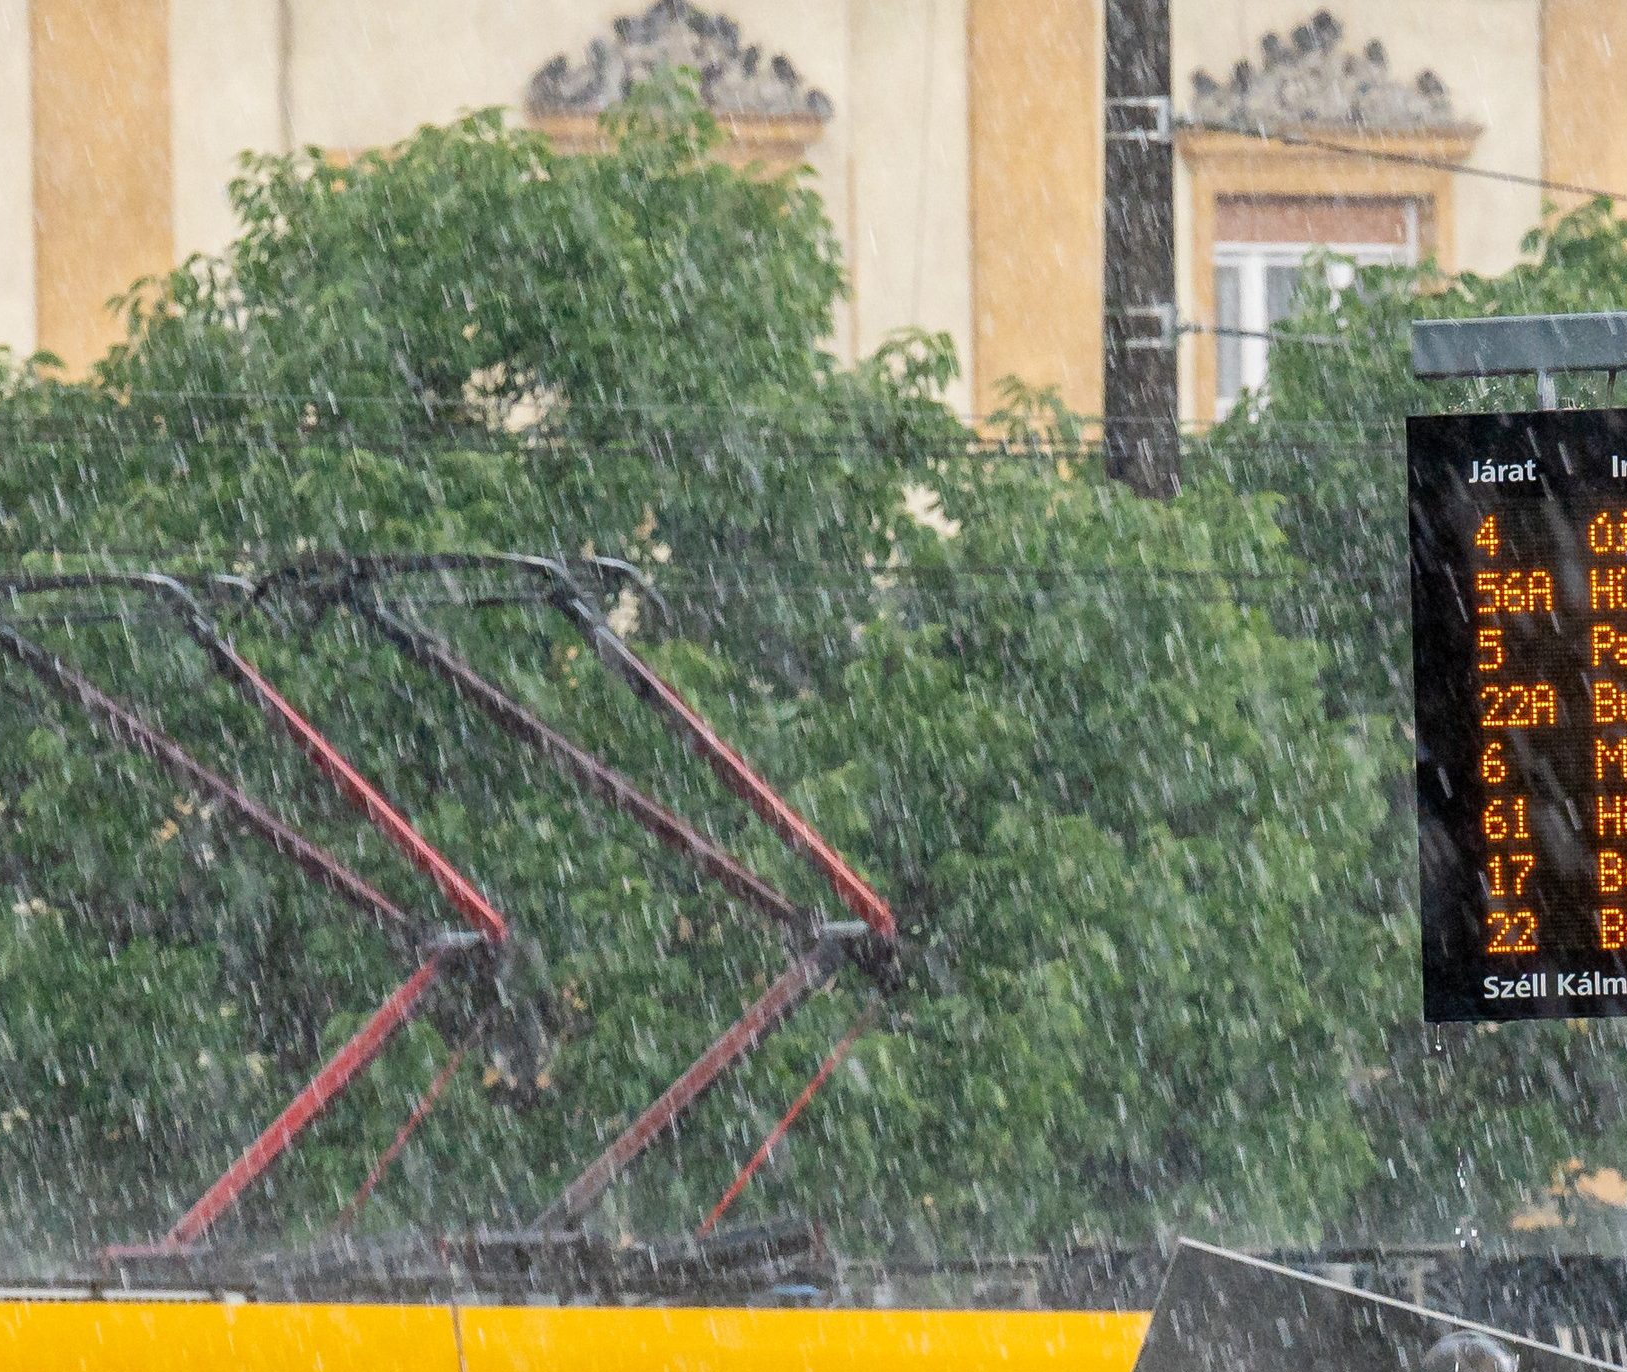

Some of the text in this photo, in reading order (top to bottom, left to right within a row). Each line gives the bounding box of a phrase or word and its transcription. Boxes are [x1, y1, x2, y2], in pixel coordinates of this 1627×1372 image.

[1468, 458, 1537, 484] Járat
[1476, 516, 1499, 556] 4
[1477, 571, 1553, 614] 56A
[1478, 629, 1503, 671] 5
[1481, 684, 1555, 727] 22A
[1482, 742, 1506, 784] 6
[1484, 798, 1529, 840] 61
[1489, 854, 1534, 896] 17
[1487, 911, 1538, 953] 22
[1482, 973, 1548, 1000] Széll
